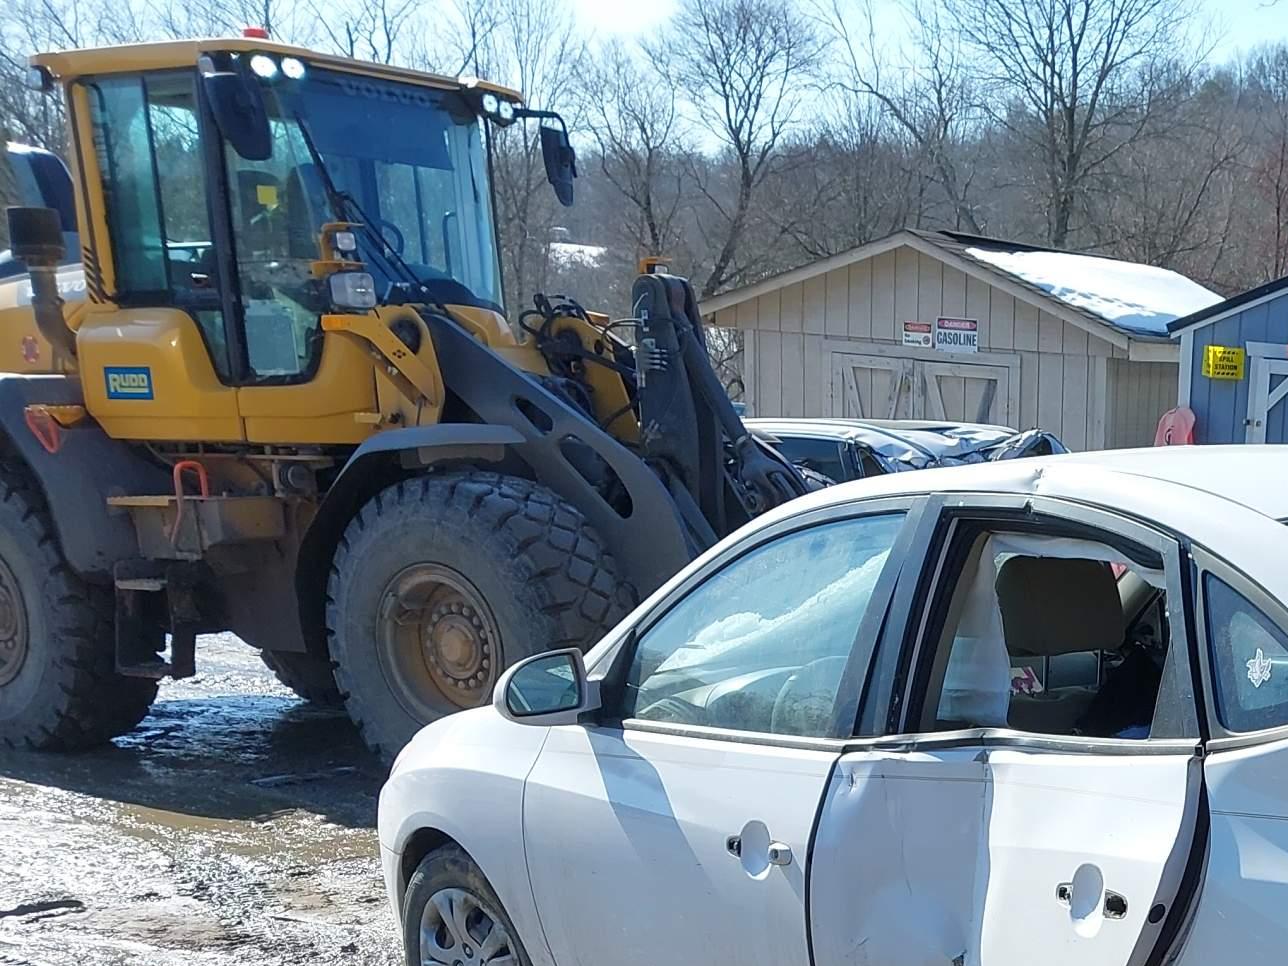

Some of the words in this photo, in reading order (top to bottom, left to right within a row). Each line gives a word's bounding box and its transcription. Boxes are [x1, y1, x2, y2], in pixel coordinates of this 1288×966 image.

[937, 332, 977, 346] GASOLINE
[1214, 363, 1238, 371] STATION
[108, 373, 149, 393] RUDD
